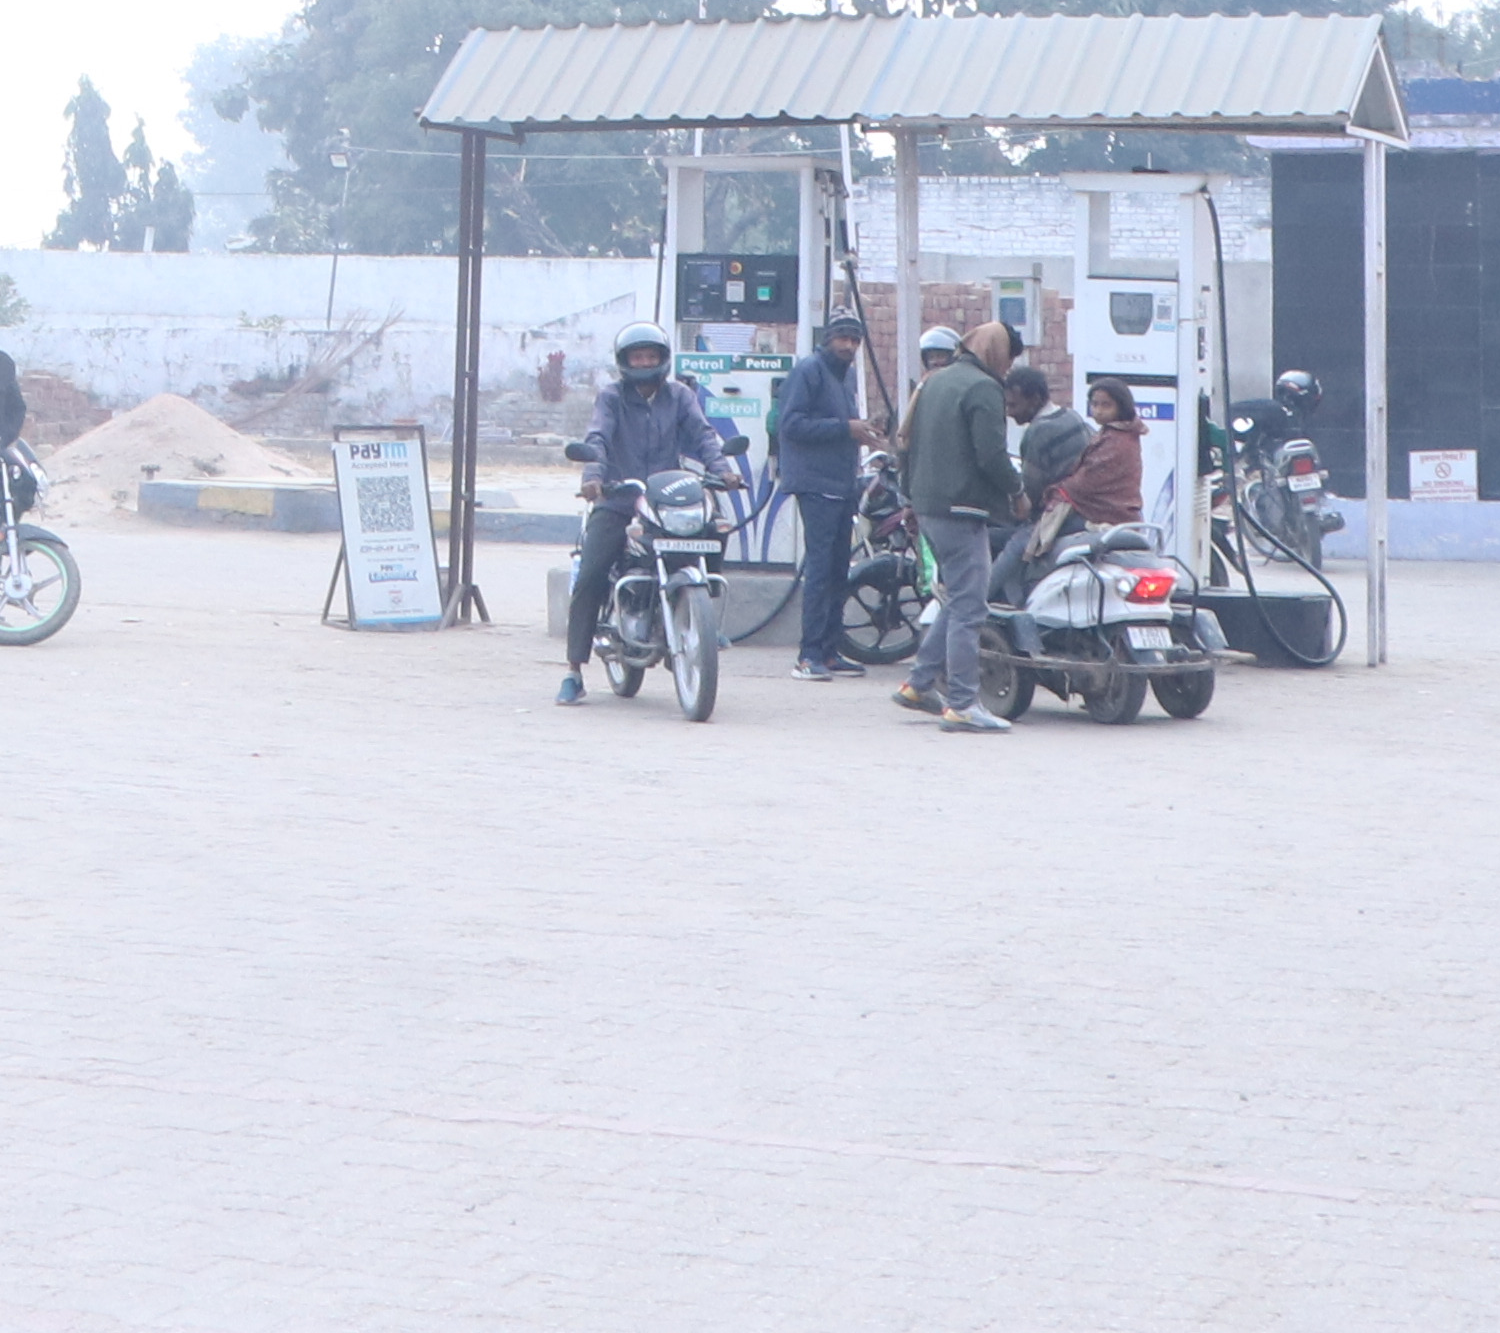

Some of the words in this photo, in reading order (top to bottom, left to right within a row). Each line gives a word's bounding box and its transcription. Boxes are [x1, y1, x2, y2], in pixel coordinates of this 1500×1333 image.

[681, 358, 724, 370] Petrol
[745, 358, 782, 369] Petrol
[710, 400, 758, 415] Petrol
[351, 461, 387, 470] Accepted
[389, 460, 409, 468] Here
